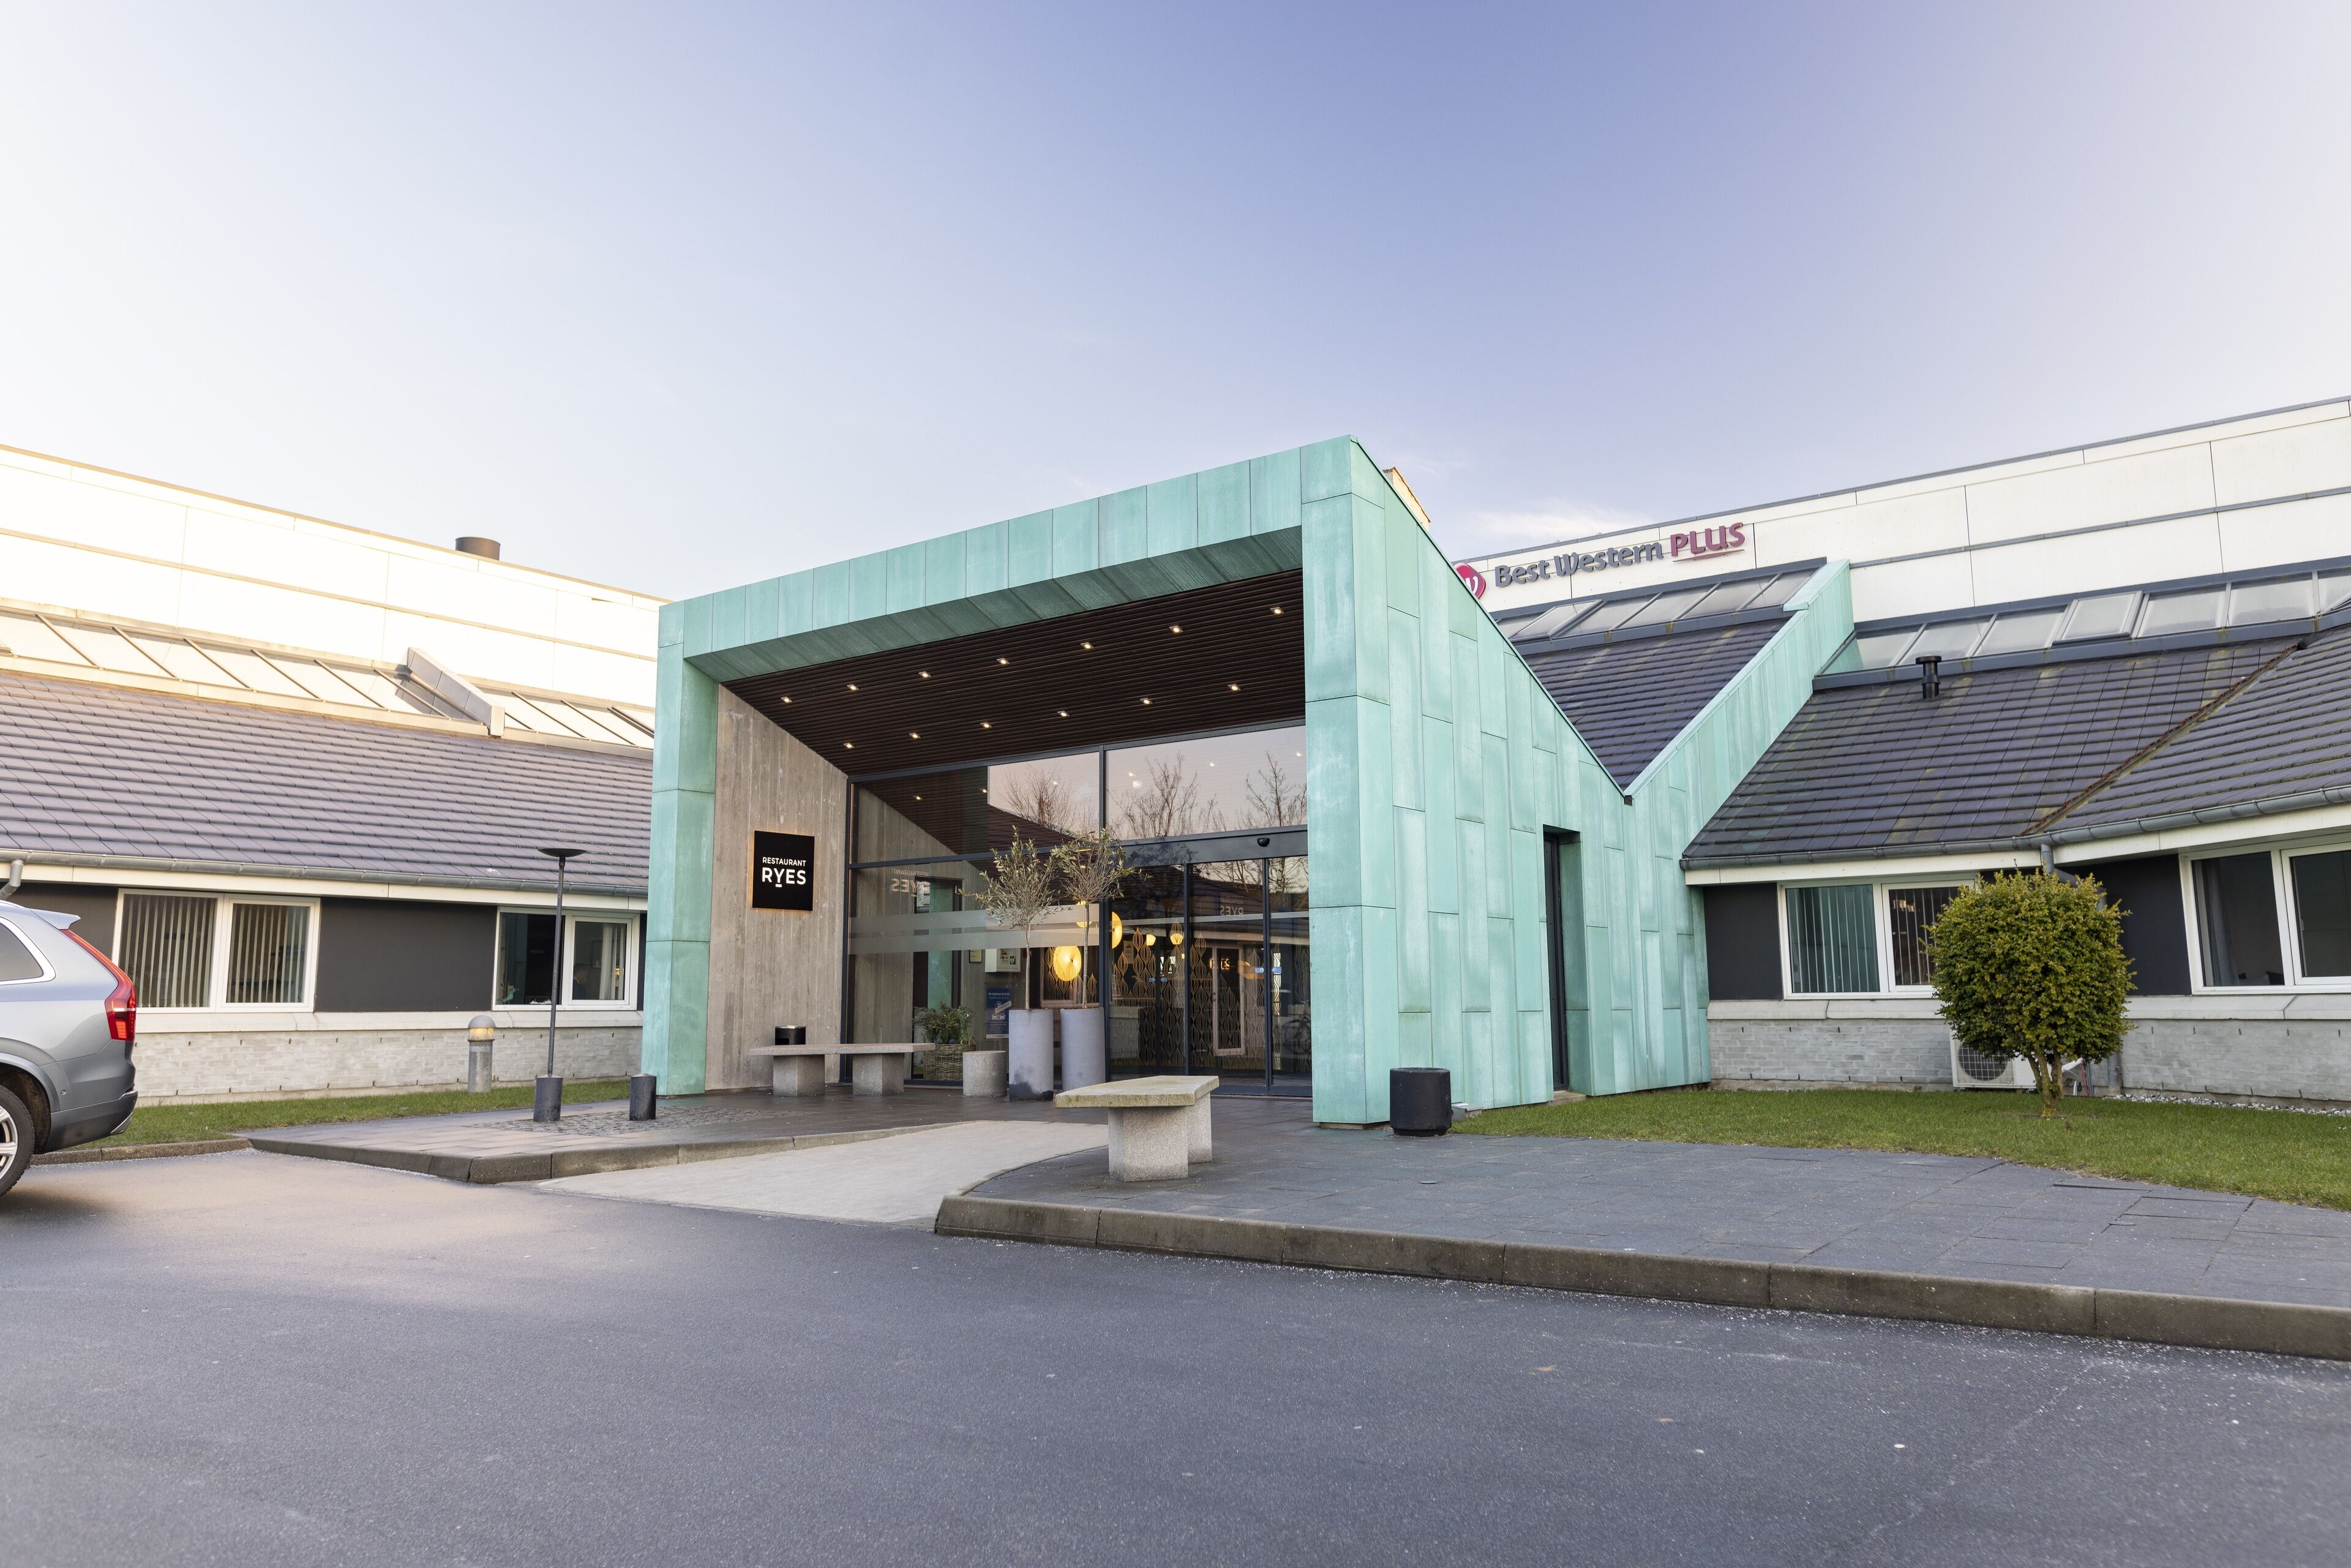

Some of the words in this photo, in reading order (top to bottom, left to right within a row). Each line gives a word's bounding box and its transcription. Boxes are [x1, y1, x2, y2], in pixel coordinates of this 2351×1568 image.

[1494, 560, 1550, 588] Best
[1553, 542, 1664, 577] Western
[1670, 522, 1745, 557] PLUS
[762, 857, 806, 867] RESTAURANT
[762, 867, 806, 885] RYES
